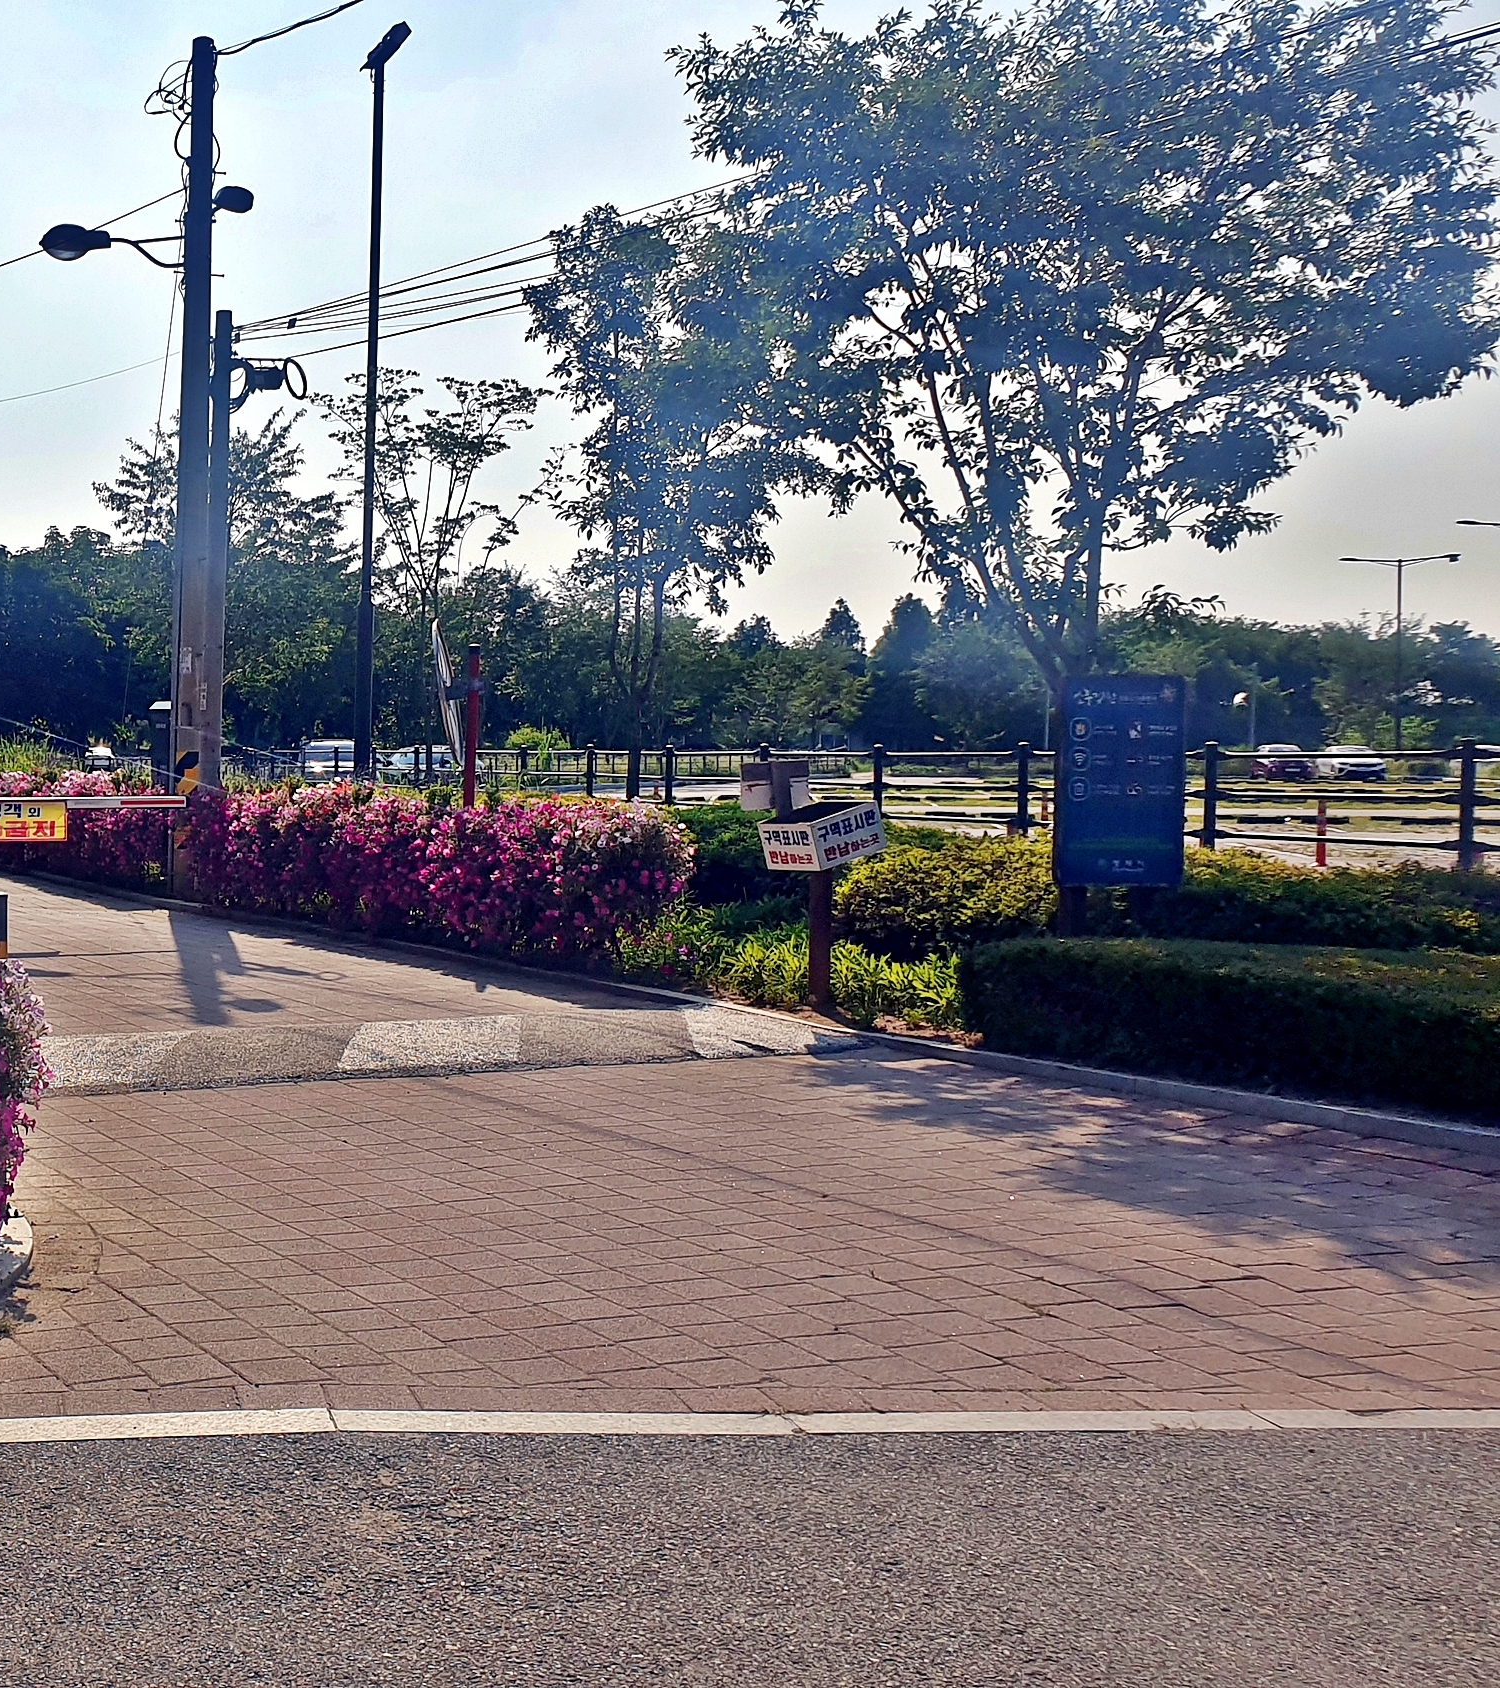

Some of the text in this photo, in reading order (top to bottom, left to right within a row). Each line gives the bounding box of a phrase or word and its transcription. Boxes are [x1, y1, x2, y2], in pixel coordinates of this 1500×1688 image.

[28, 807, 41, 818] 외
[817, 809, 877, 843] 구역표시판
[762, 830, 810, 846] 구역표시판
[824, 832, 880, 862] 반납하는곳
[768, 850, 814, 865] 반납하는곳
